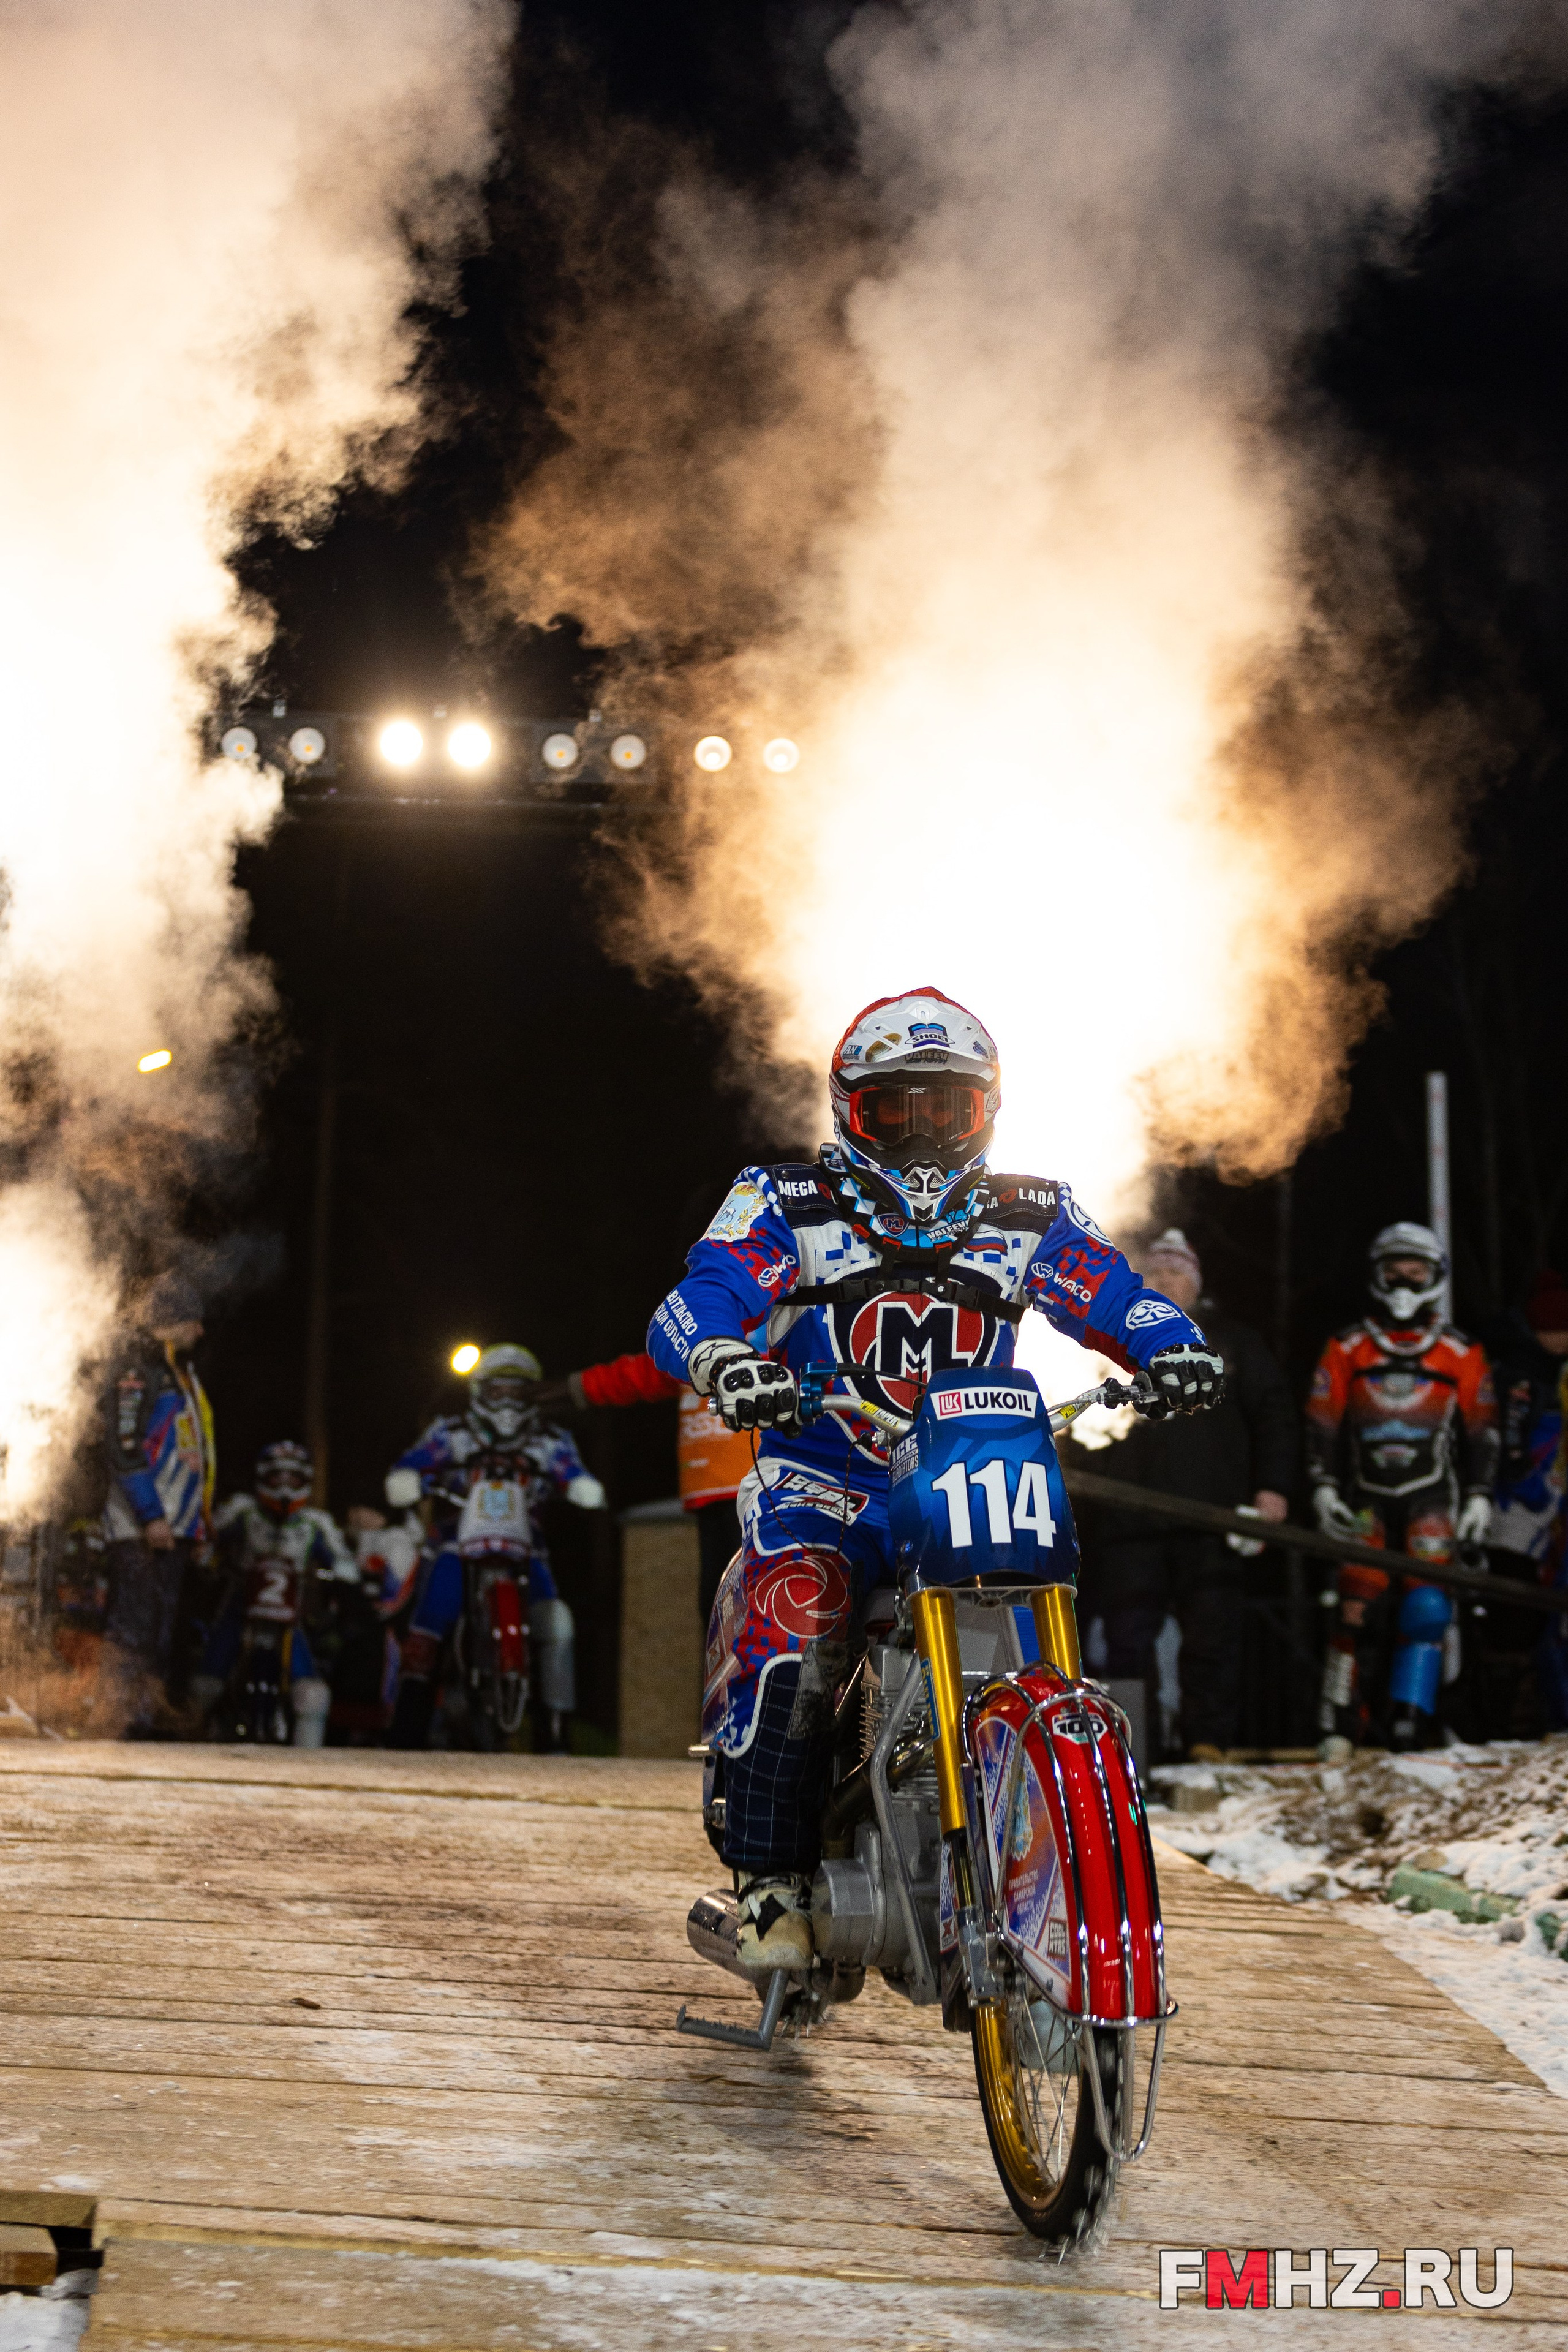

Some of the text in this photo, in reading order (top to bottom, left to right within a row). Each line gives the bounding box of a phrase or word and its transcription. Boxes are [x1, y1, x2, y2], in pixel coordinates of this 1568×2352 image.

[911, 1033, 949, 1043] SHOEI
[905, 1050, 949, 1061] VALEEV
[777, 1180, 818, 1197] MEGA
[1019, 1188, 1056, 1205] LADA
[1054, 1272, 1092, 1302] WACO
[964, 1392, 1032, 1412] LUKOIL
[892, 1433, 918, 1465] ICE
[932, 1460, 1057, 1548] 114
[257, 1571, 288, 1604] 2
